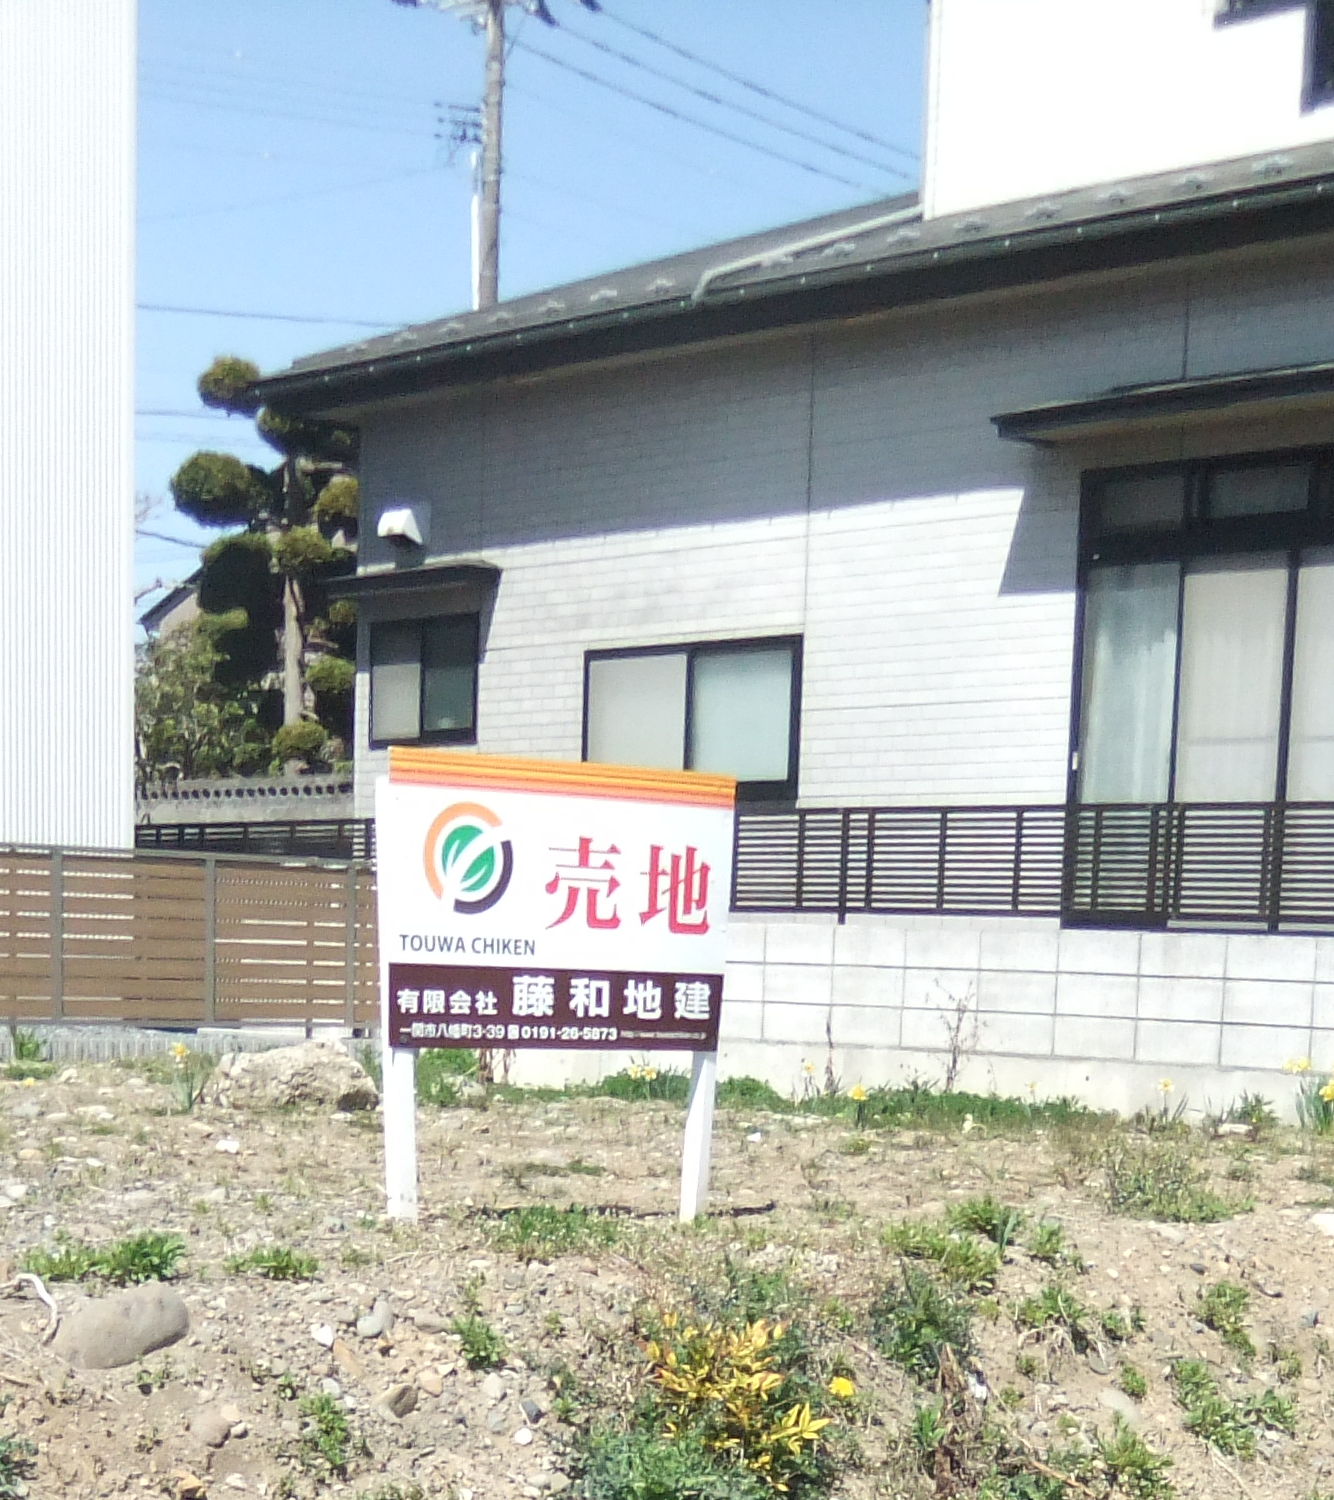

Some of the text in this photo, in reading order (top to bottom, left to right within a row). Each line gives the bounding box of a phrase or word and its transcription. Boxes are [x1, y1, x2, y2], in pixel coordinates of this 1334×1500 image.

[544, 836, 711, 934] 売地
[399, 934, 536, 956] TOUWA CHIKEN
[397, 974, 711, 1021] 有限会社 藤和地建
